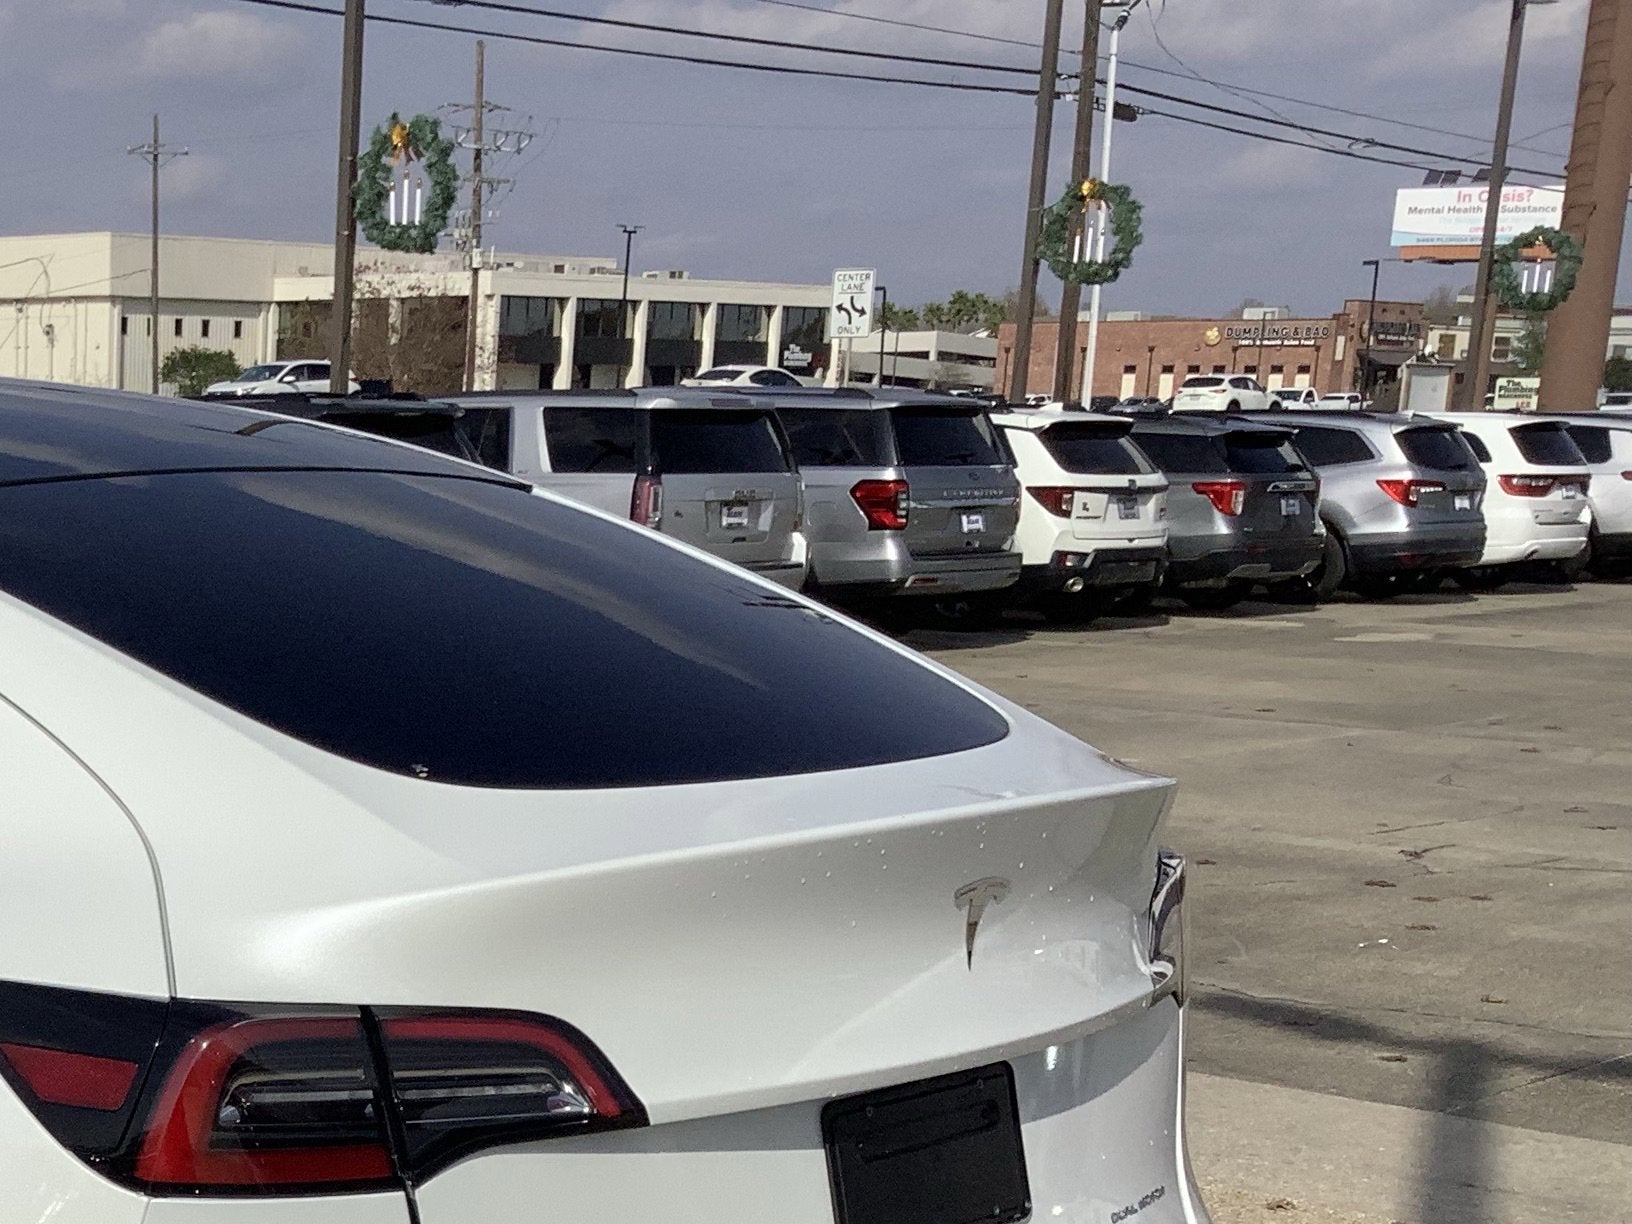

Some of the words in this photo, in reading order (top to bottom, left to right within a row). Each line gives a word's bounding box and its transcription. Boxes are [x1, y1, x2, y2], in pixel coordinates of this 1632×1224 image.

[1456, 190, 1473, 203] In
[1478, 189, 1535, 203] Csis?
[1407, 206, 1445, 215] Mental
[1447, 204, 1483, 214] Health
[1500, 204, 1557, 214] Substance
[836, 272, 872, 282] CENTER
[841, 282, 866, 292] LANE
[836, 325, 861, 336] ONLY
[1304, 326, 1329, 338] BAO
